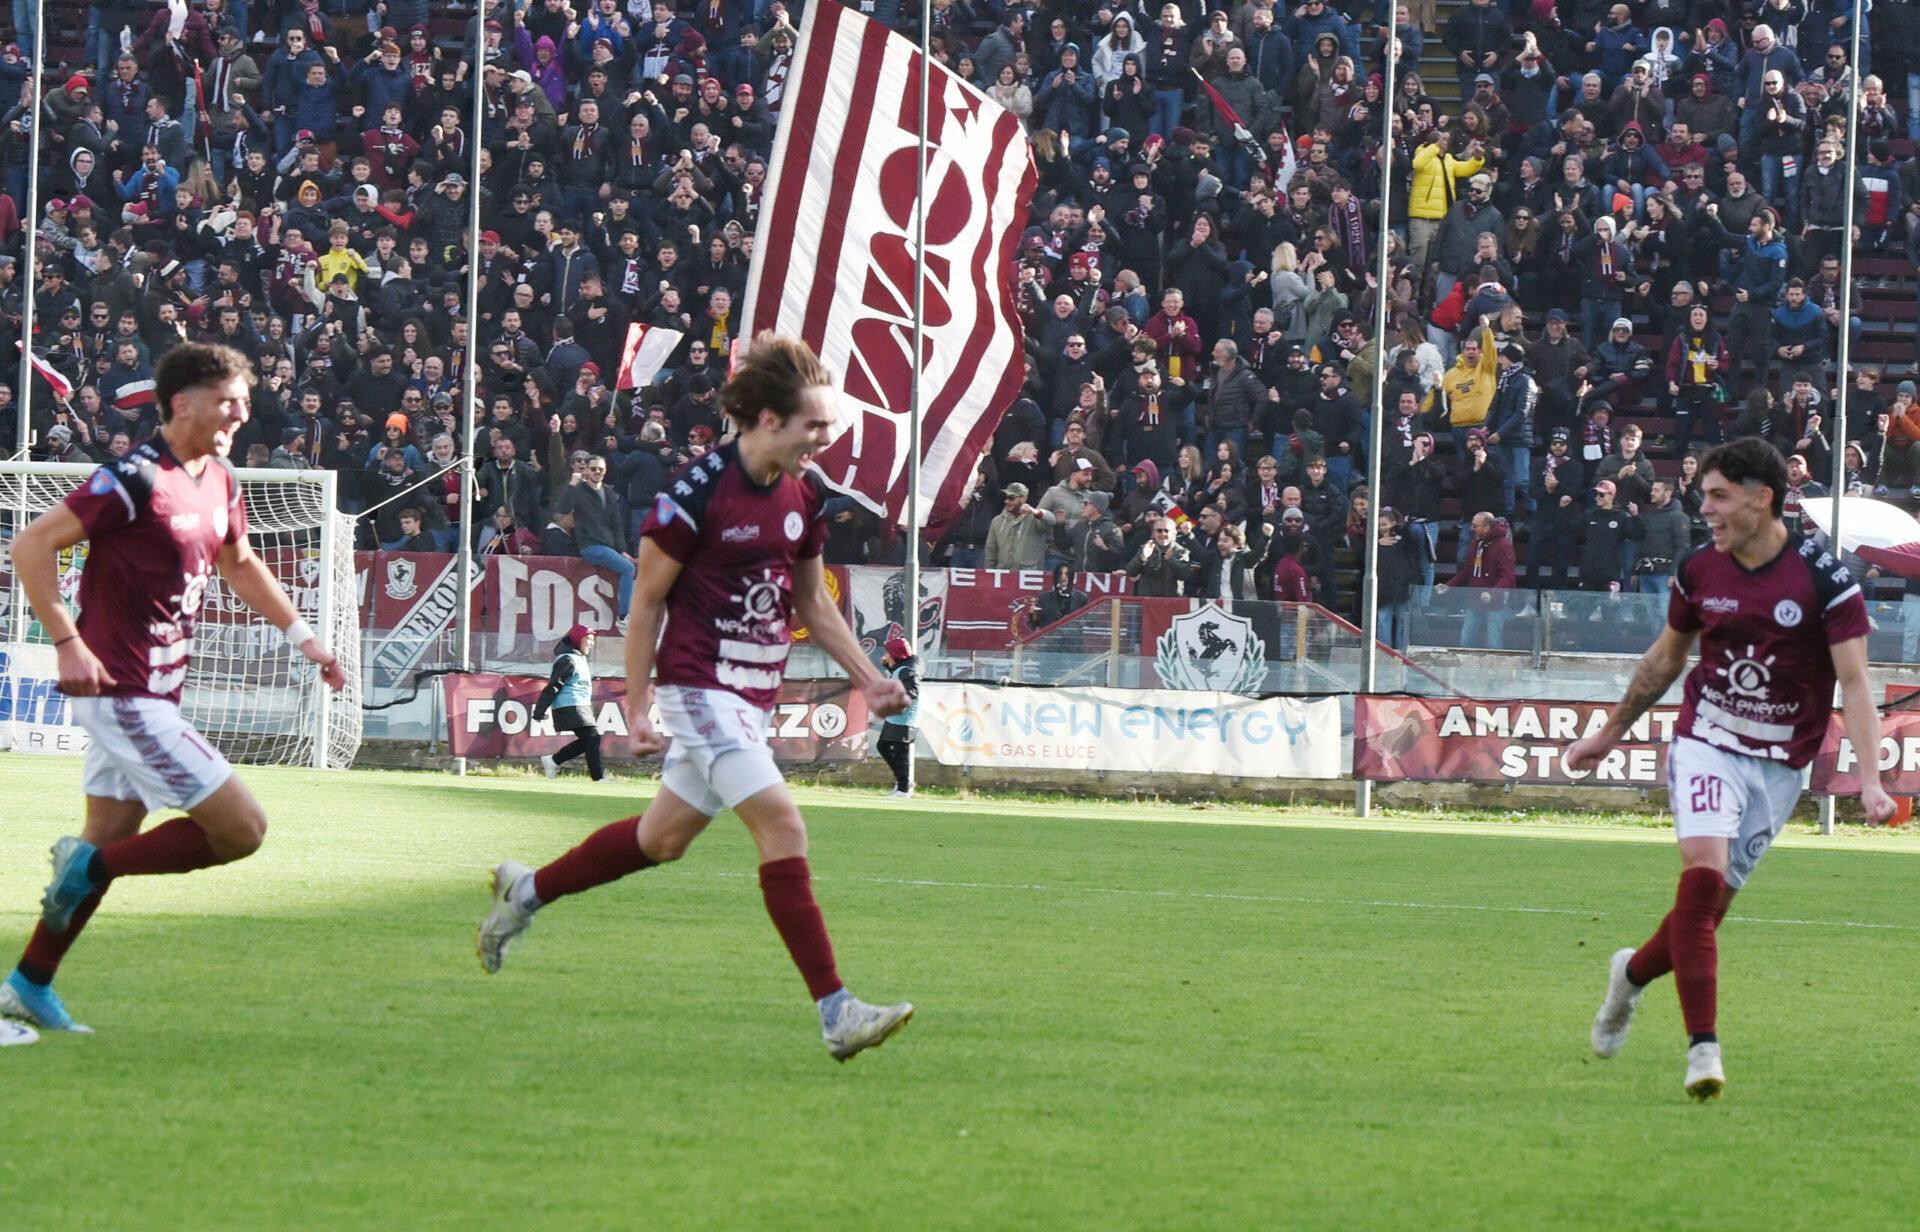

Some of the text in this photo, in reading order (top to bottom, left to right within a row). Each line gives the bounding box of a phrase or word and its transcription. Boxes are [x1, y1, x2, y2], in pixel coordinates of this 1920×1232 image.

[950, 567, 1127, 594] ETENI
[466, 698, 629, 738] FORA
[1000, 743, 1096, 759] GAS E LUCE
[1690, 774, 1722, 813] 20
